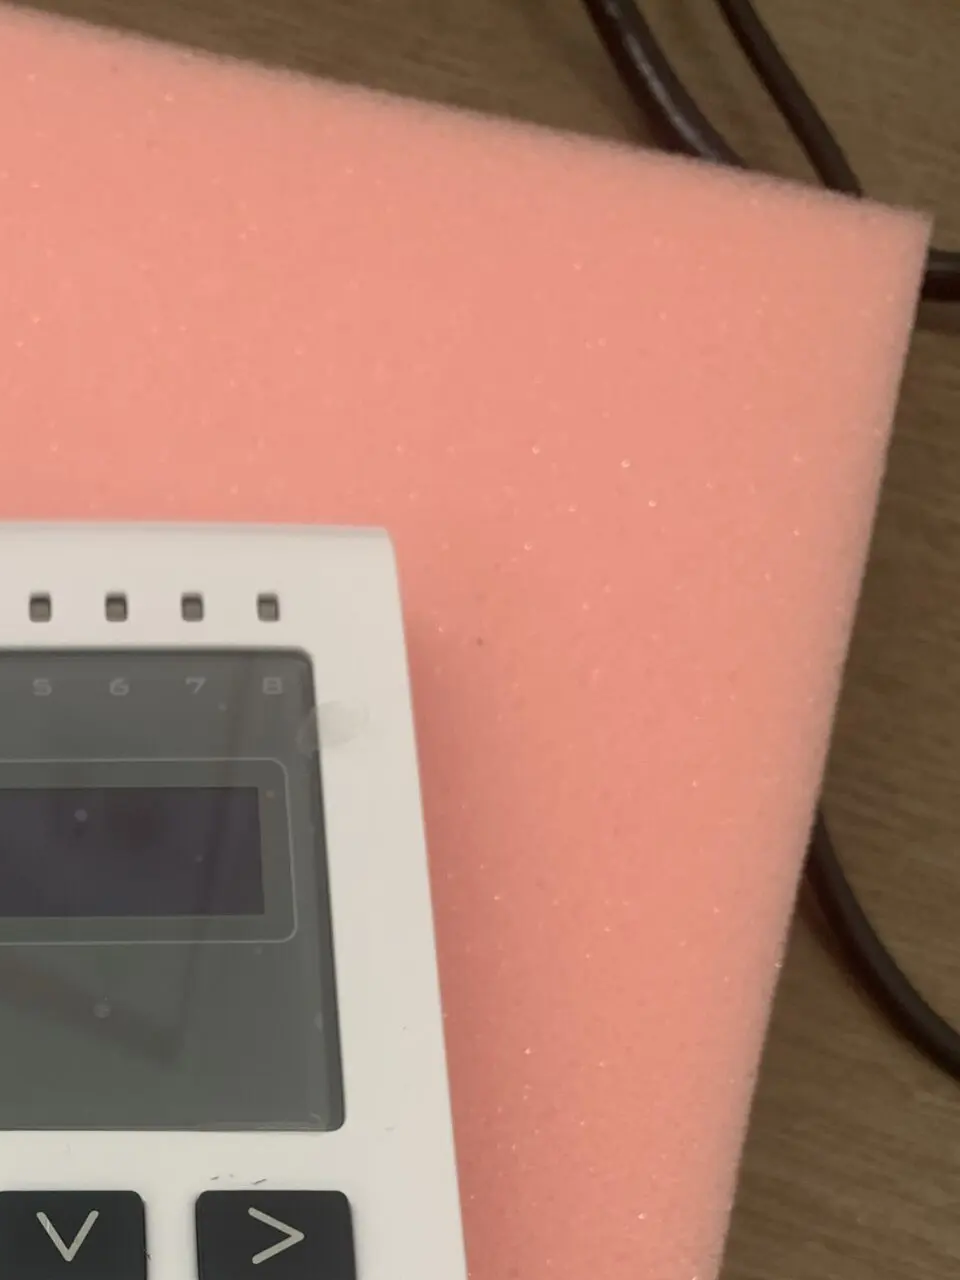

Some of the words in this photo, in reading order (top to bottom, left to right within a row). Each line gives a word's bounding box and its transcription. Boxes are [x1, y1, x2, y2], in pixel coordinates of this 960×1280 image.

[32, 678, 52, 696] 5
[109, 678, 130, 696] 6
[185, 676, 207, 694] 7
[262, 676, 284, 695] 8
